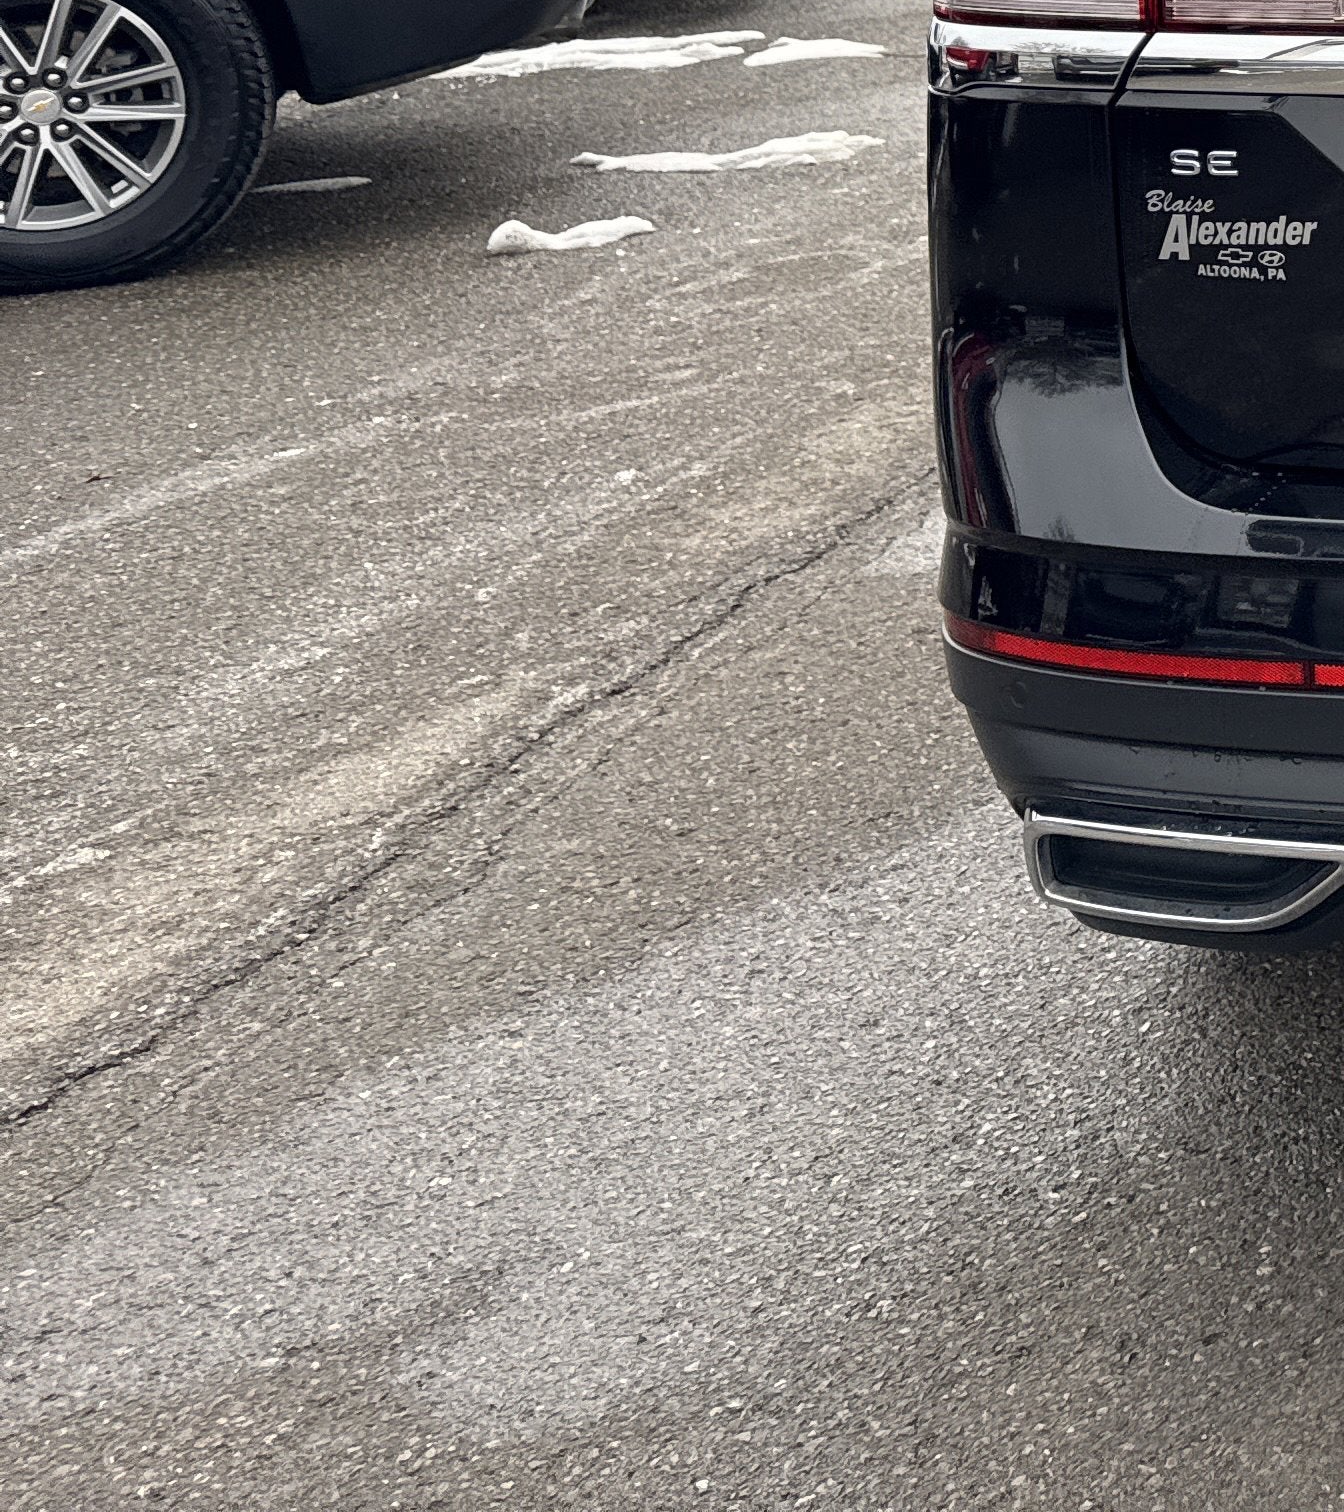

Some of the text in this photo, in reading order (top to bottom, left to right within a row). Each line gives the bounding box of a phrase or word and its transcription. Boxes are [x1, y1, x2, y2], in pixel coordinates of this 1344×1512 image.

[1169, 148, 1240, 177] SE
[1145, 189, 1216, 213] Blaise
[1157, 214, 1319, 261] Alexander
[1197, 263, 1287, 282] ALTOONA, PA
